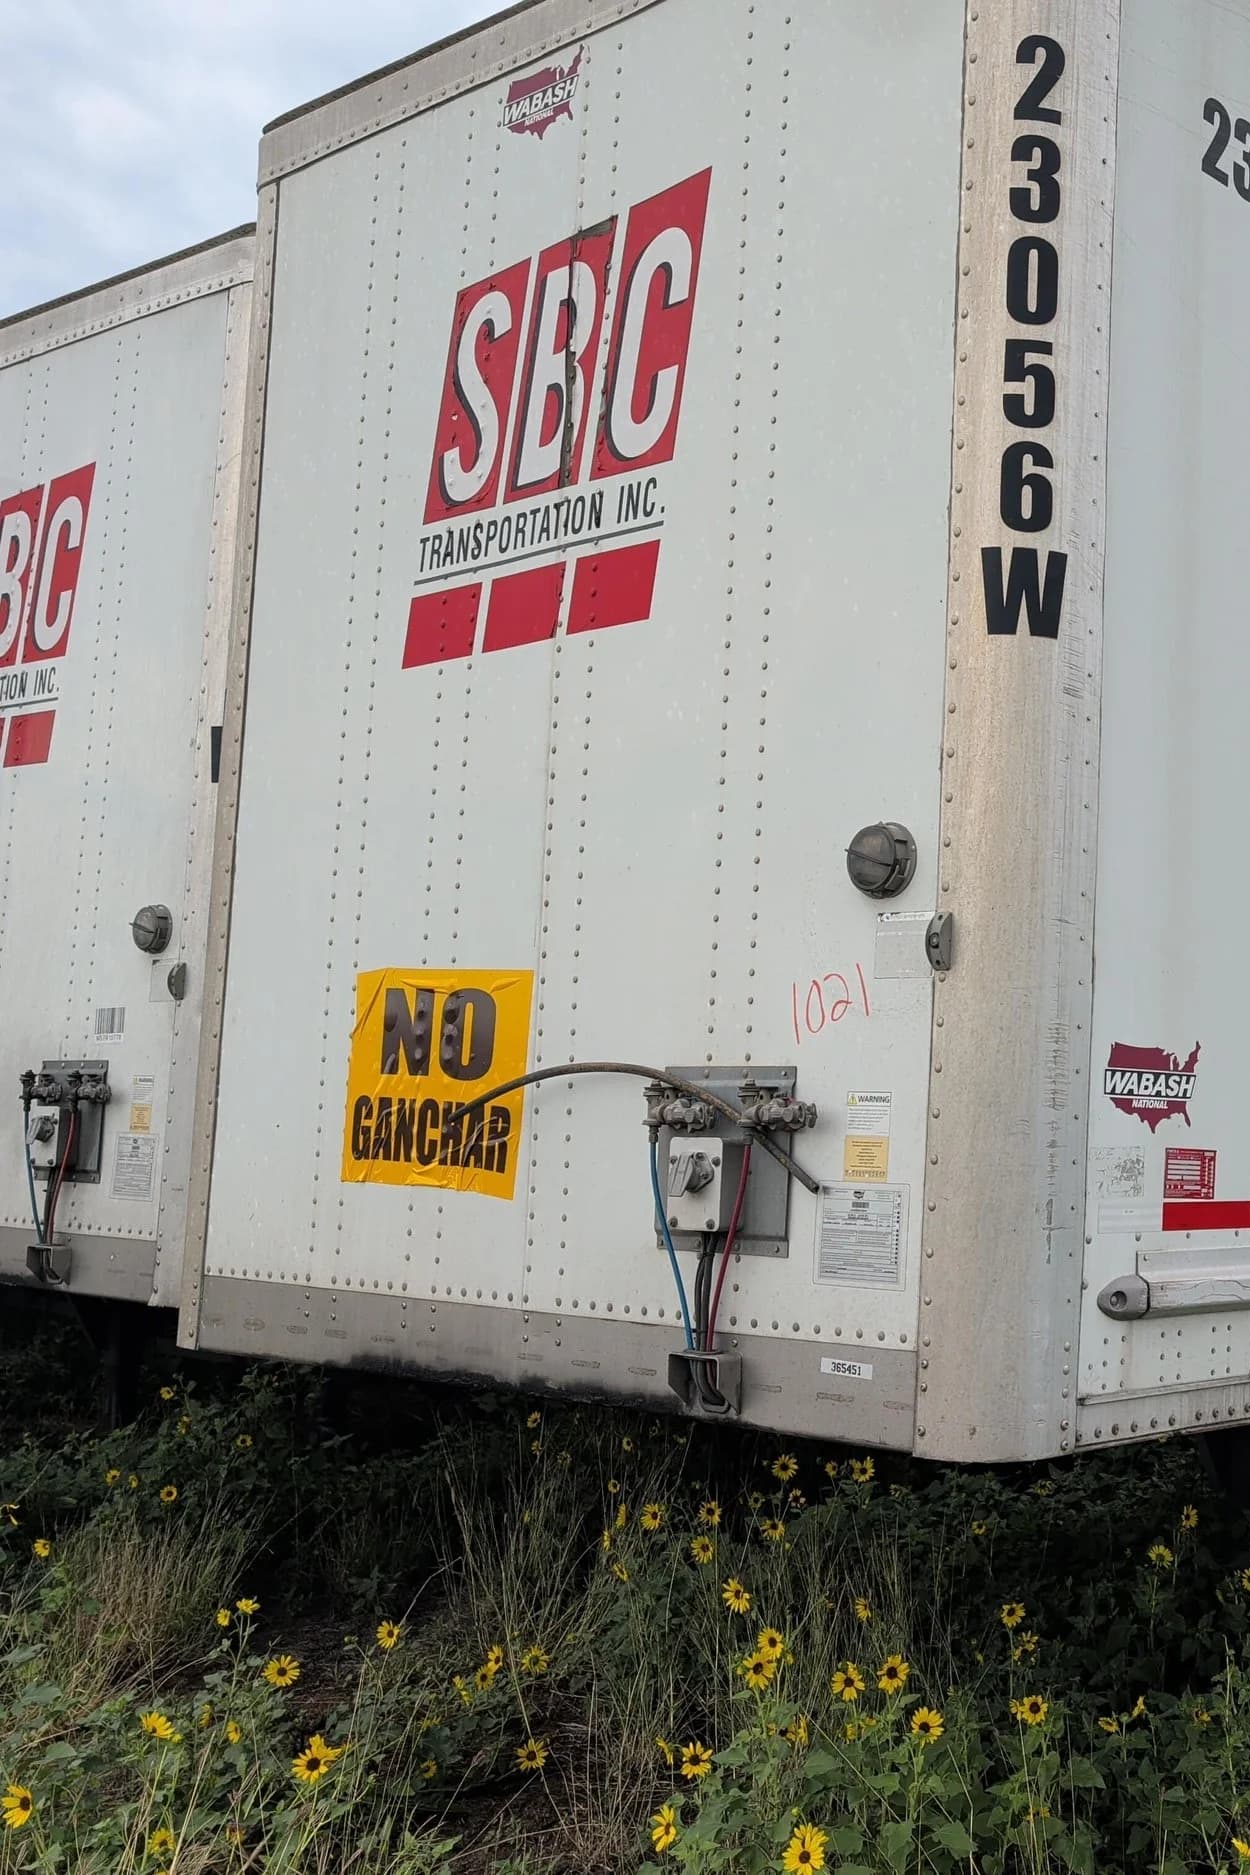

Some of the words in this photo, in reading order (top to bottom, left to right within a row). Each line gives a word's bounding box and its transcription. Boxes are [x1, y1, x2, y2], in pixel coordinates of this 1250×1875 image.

[504, 76, 578, 125] WABASH
[440, 227, 693, 504] SBC
[981, 34, 1067, 639] 23056W
[420, 491, 604, 573] TRANSPORTATION
[617, 477, 665, 524] INC.
[33, 666, 59, 696] INC.
[381, 988, 497, 1081] NO
[792, 963, 871, 1045] 1021
[858, 1095, 890, 1104] WARNING
[1105, 1071, 1195, 1098] WABASH
[1132, 1099, 1169, 1109] NATIONAL
[352, 1095, 512, 1174] GANCHAR
[830, 1361, 862, 1376] 365451
